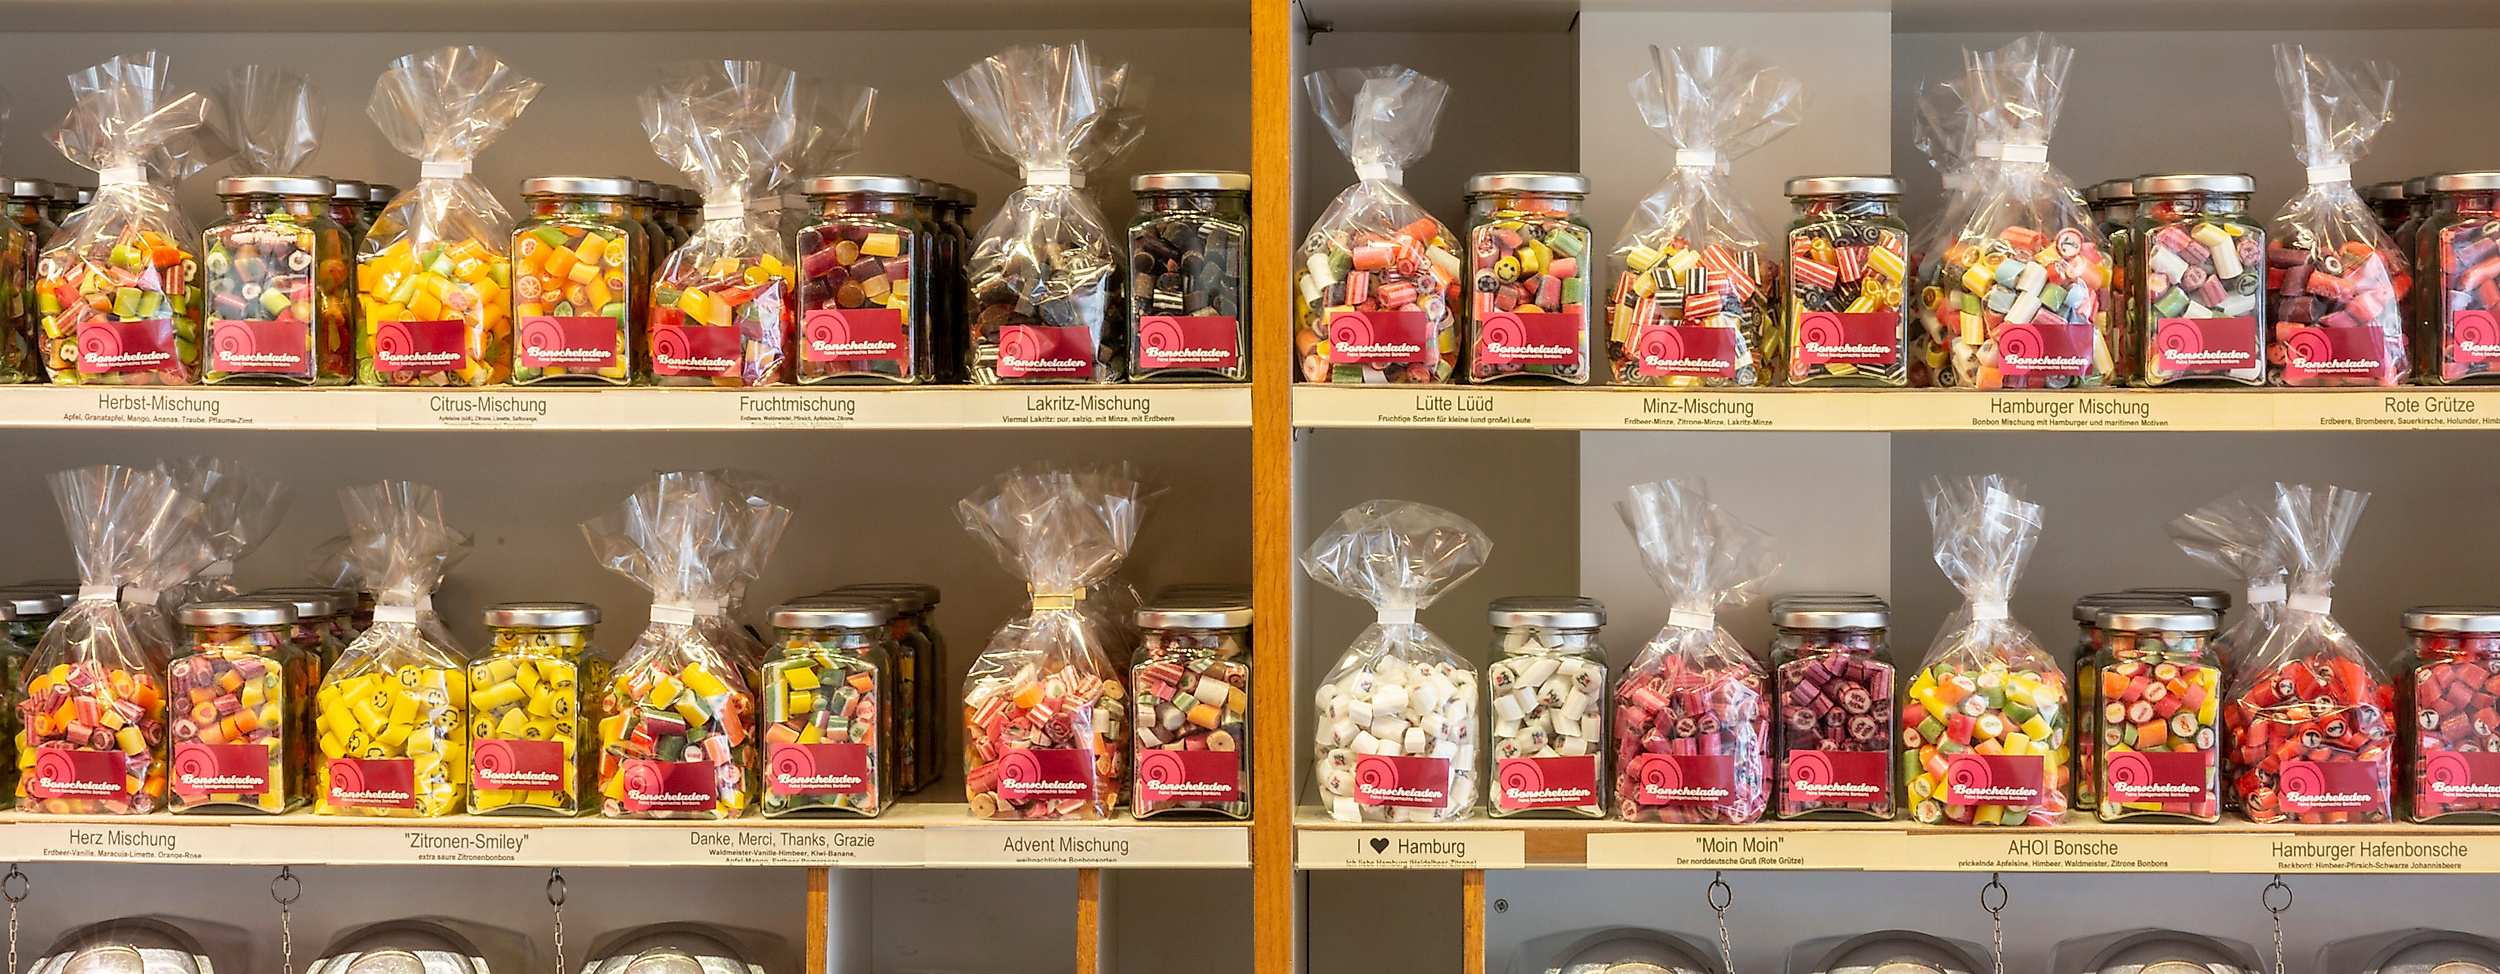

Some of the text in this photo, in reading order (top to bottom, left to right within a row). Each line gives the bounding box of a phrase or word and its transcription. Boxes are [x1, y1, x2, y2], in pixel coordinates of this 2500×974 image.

[812, 340, 896, 351] Bonscheladen
[1335, 342, 1420, 353] Bonscheladen
[1488, 343, 1572, 354] Bonscheladen
[1806, 343, 1890, 354] Bonscheladen
[85, 351, 170, 363] Bonscheladen
[220, 351, 300, 363] Bonscheladen
[379, 351, 460, 361] Bonscheladen
[527, 347, 611, 358] Bonscheladen
[1146, 347, 1230, 358] Bonscheladen
[2165, 350, 2249, 360] Bonscheladen
[658, 355, 735, 366] Bonscheladen
[1003, 356, 1086, 367] Bonscheladen
[1646, 356, 1729, 368] Bonscheladen
[2005, 355, 2088, 365] Bonscheladen
[2293, 358, 2379, 368] Bonscheladen
[99, 394, 220, 416] Herbst-Mischung
[430, 396, 547, 415] Citrus-Mischung
[740, 396, 856, 415] Fruchtmischung
[1027, 395, 1150, 414] Lakritz-Mischung
[1416, 395, 1494, 412] Lütte Lüüd
[1643, 398, 1754, 417] Minz-Mischung
[1991, 398, 2150, 417] Hamburger Mischung
[2385, 397, 2475, 413] Rote Grütze
[1378, 415, 1411, 423] Fruchtige
[1437, 415, 1447, 423] für
[1470, 416, 1486, 424] (und
[1488, 416, 1510, 424] große)
[1624, 418, 1773, 426] Erdbeer-Minze, Zitrone-Minze, Lakritz-Minze
[1972, 418, 2168, 426] Bonbon Mischung mit Hamburger und maritimen Motiven
[2320, 417, 2354, 425] Erdbeere,
[2356, 417, 2396, 425] Brombeere,
[2398, 417, 2445, 425] Sauerkirsche,
[2447, 417, 2481, 425] Holunder,
[181, 774, 263, 785] Bonscheladen
[480, 769, 558, 780] Bonscheladen
[778, 774, 861, 784] Bonscheladen
[40, 778, 120, 791] Bonscheladen
[1003, 779, 1087, 790] Bonscheladen
[1147, 780, 1231, 791] Bonscheladen
[1646, 784, 1728, 796] Bonscheladen
[1795, 781, 1879, 793] Bonscheladen
[1953, 784, 2037, 795] Bonscheladen
[2114, 782, 2199, 793] Bonscheladen
[332, 788, 409, 799] Bonscheladen
[628, 790, 710, 801] Bonscheladen
[1360, 784, 1442, 798] Bonscheladen
[1507, 788, 1590, 798] Bonscheladen
[2286, 792, 2371, 802] Bonscheladen
[70, 829, 176, 850] Herz Mischung
[405, 833, 529, 852] "Zitronen-Smiley"
[690, 831, 875, 848] Danke, Merci, Thanks, Grazie
[1696, 837, 1784, 853] "Moin Moin"
[1004, 836, 1129, 855] Advent Mischung
[1357, 838, 1465, 857] I Hamburg
[2008, 839, 2118, 855] AHOI Bonsche
[2272, 841, 2468, 860] Hamburger Hafenbonsche
[709, 849, 856, 857] Waldmeister-Vanille-Himbeer, Kiwi-Banane,
[1677, 857, 1804, 865] Der norddeutsche Gruß (Rote Grütze)
[1958, 860, 2168, 868] prickelnde Apfelsine, Himbeer, Waldmeister, Zitrone Bonbons
